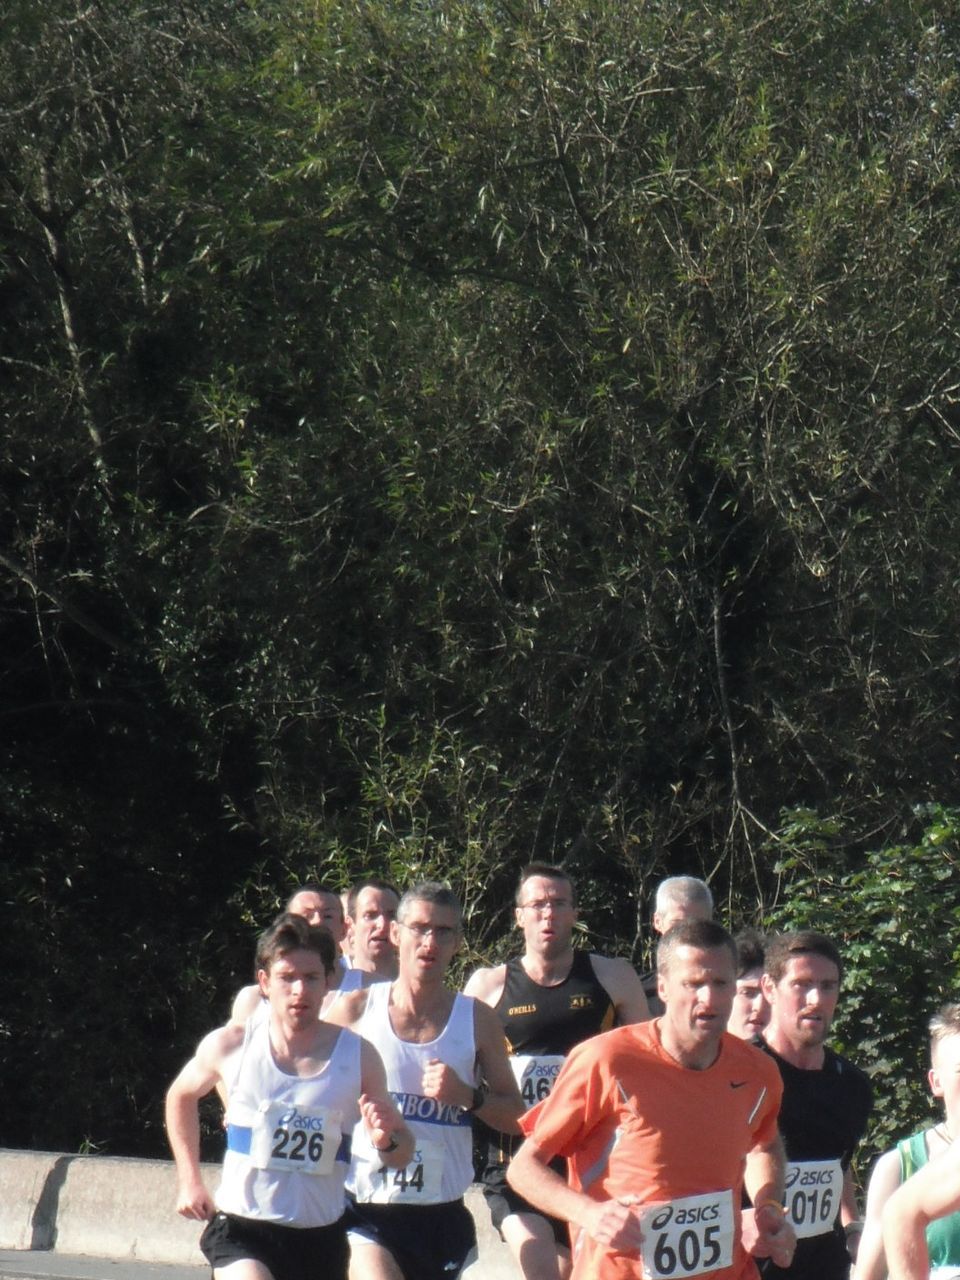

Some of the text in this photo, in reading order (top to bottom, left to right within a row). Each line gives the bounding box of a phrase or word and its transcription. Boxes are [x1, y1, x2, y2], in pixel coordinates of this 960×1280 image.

[521, 1077, 557, 1105] 46
[293, 1115, 323, 1131] asics
[391, 1093, 464, 1125] NBOYNE
[271, 1128, 325, 1162] 226
[800, 1169, 834, 1186] asics
[675, 1203, 720, 1225] asics
[784, 1188, 833, 1225] 016
[653, 1225, 721, 1275] 605
